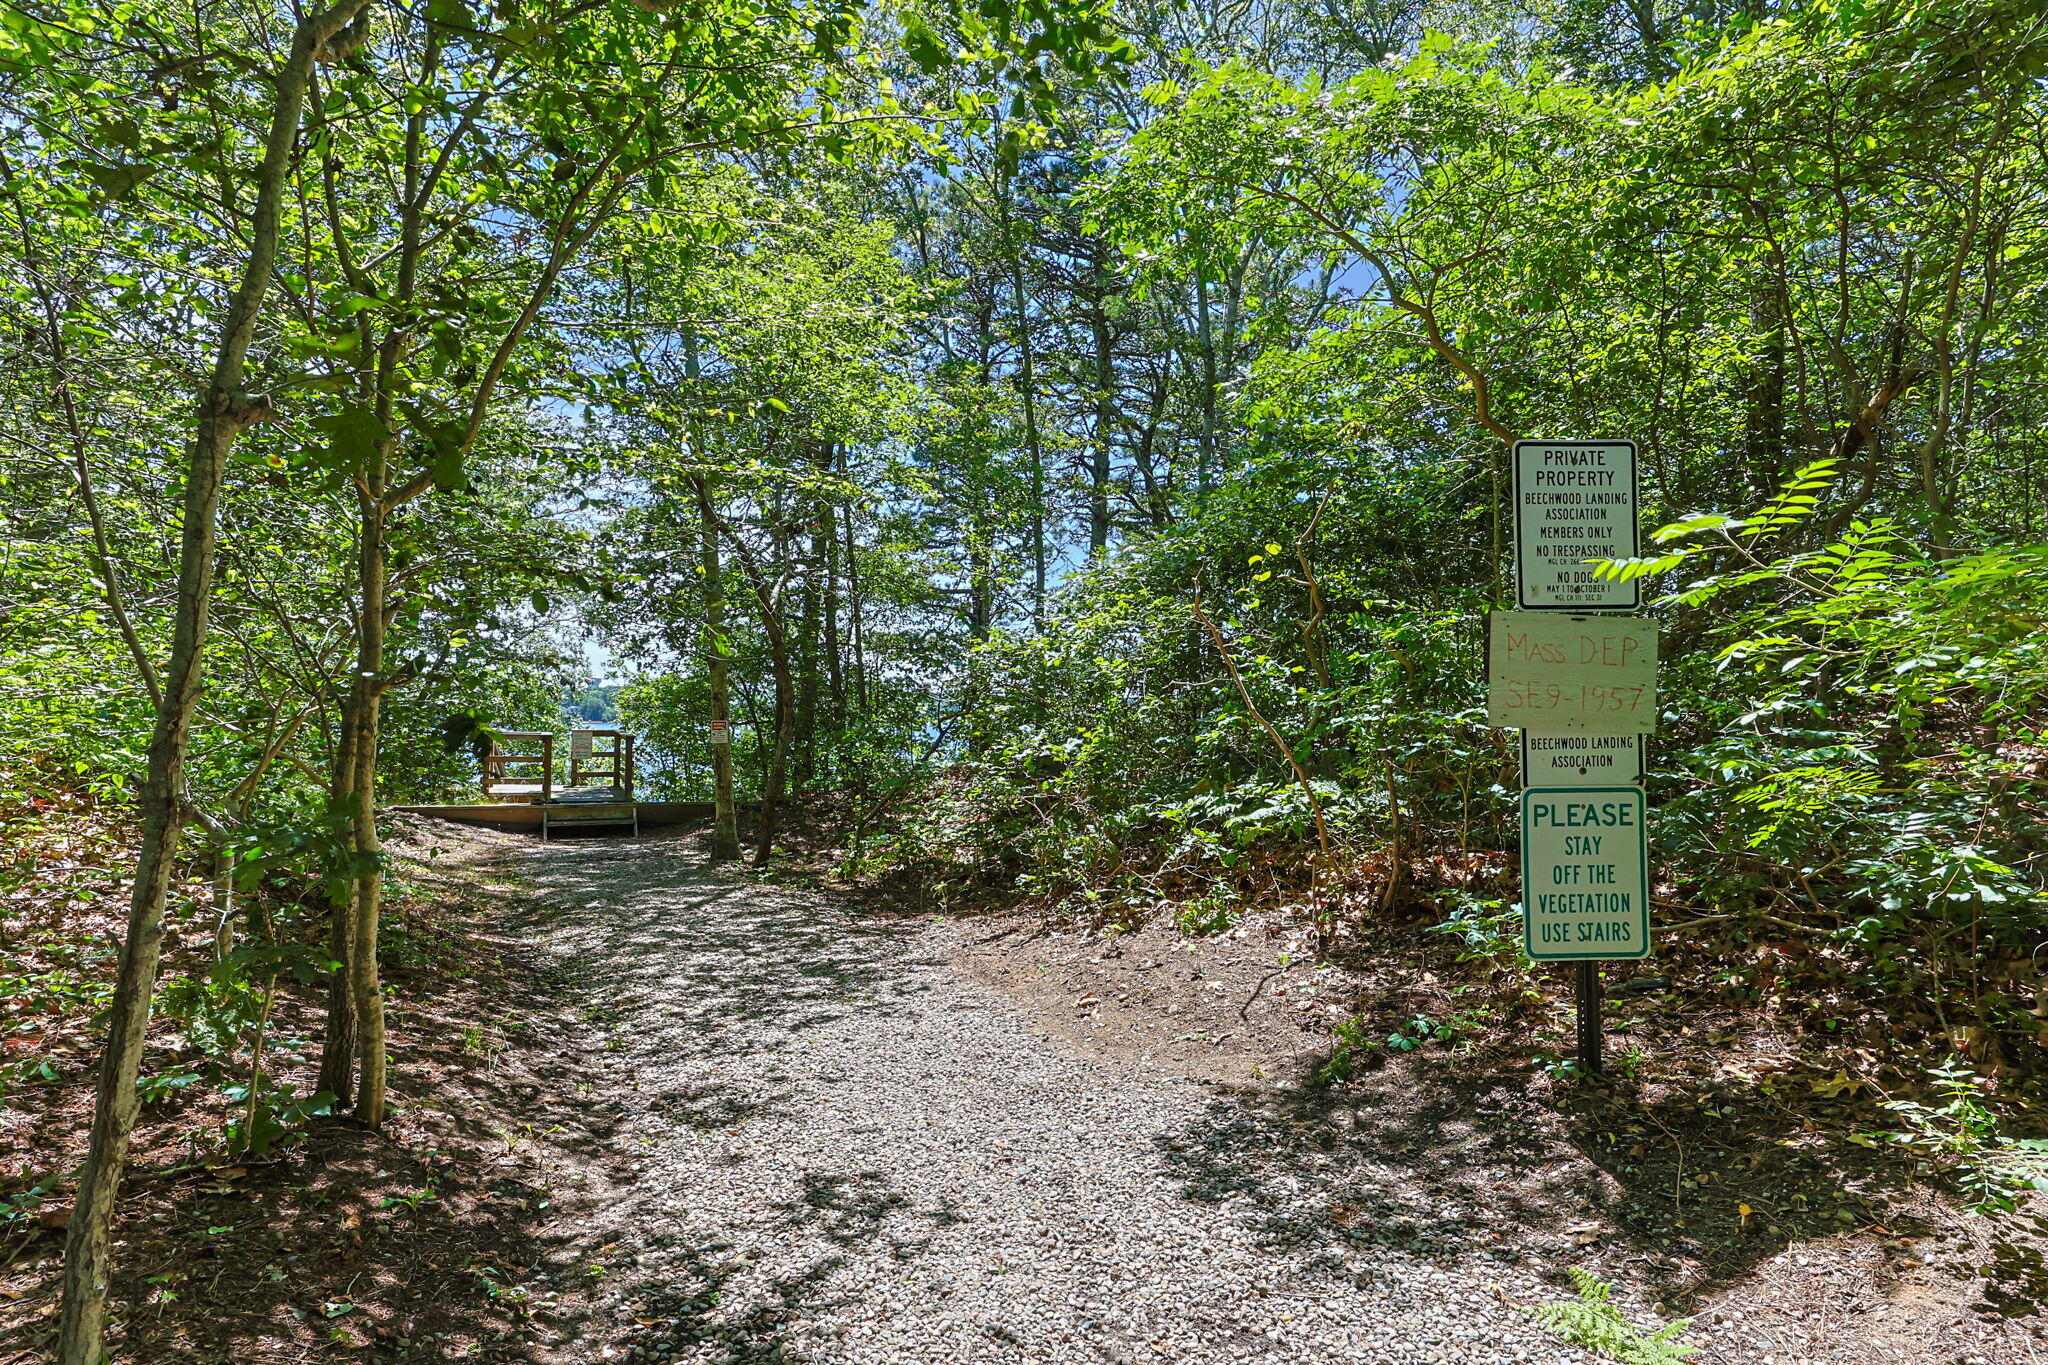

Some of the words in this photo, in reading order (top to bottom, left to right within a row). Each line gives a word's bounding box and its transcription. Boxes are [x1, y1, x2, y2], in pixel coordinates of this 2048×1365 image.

[1544, 450, 1606, 466] PRIVATE
[1536, 471, 1615, 486] PROPERTY
[1525, 492, 1581, 505] BEECHWOOD
[1586, 492, 1627, 504] LANDING
[1545, 508, 1607, 520] ASSOCIATION
[1540, 526, 1584, 538] MEMBERS
[1588, 526, 1613, 538] ONLY
[1536, 545, 1549, 557] NO
[1553, 545, 1616, 557] TRESPASSING
[1558, 572, 1570, 583] NO
[1579, 635, 1638, 667] DEP
[1506, 680, 1644, 712] SE9-1957
[1531, 738, 1588, 750] BEECHWOOD
[1592, 736, 1633, 749] LANDING
[1552, 755, 1612, 768] ASSOCIATION
[1534, 804, 1634, 827] PLEASE
[1565, 836, 1602, 856] STAY
[1553, 865, 1581, 884] OFF
[1588, 864, 1616, 884] THE
[1539, 893, 1630, 913] VEGETATION
[1542, 923, 1570, 942] USE
[1578, 922, 1630, 942] STAIRS
